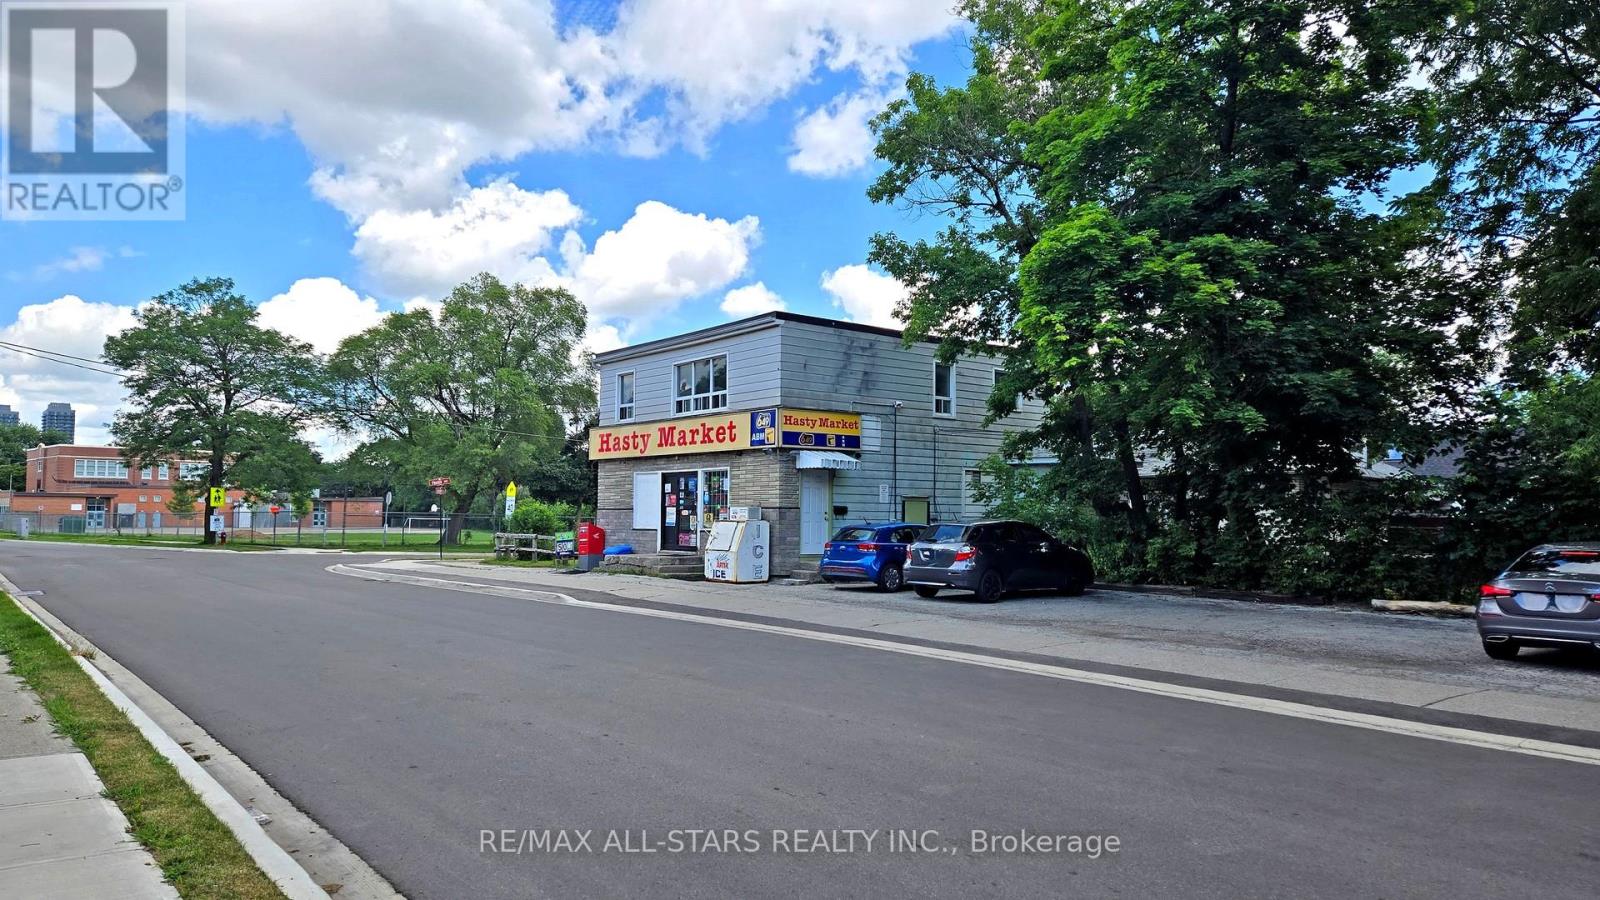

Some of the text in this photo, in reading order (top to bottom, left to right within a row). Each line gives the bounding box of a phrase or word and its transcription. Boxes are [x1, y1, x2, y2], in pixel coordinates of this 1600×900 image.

[783, 415, 859, 430] Hasty Market
[598, 420, 737, 455] Hasty Market
[711, 569, 727, 579] ICE
